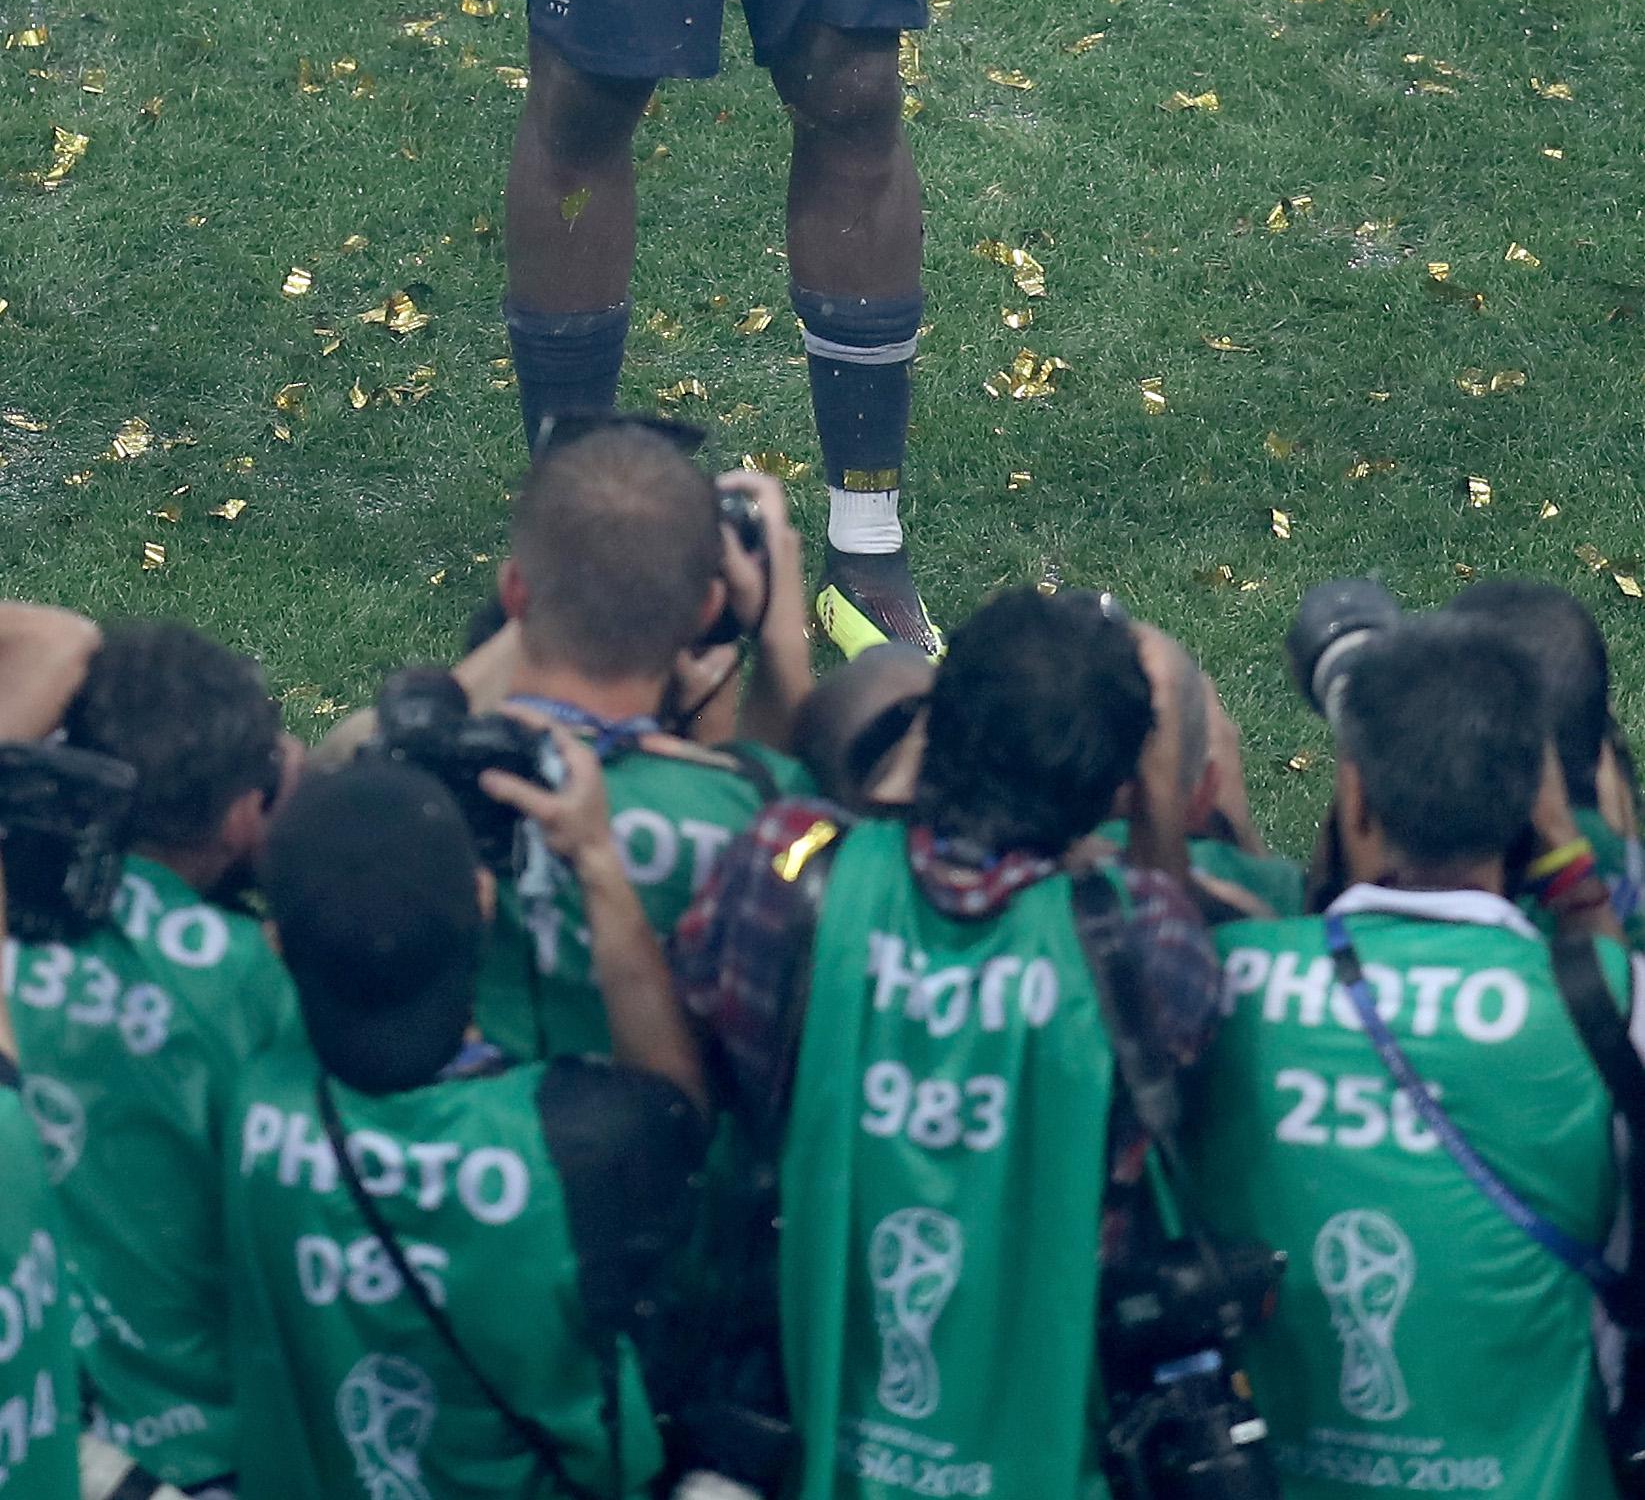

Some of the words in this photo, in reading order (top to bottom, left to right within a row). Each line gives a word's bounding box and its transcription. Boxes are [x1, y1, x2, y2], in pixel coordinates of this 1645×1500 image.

[110, 872, 229, 968] TO
[1218, 947, 1531, 1043] PHOTO
[860, 1060, 1008, 1151] 983
[1275, 1067, 1443, 1152] 256
[241, 1102, 531, 1226] PHOTO
